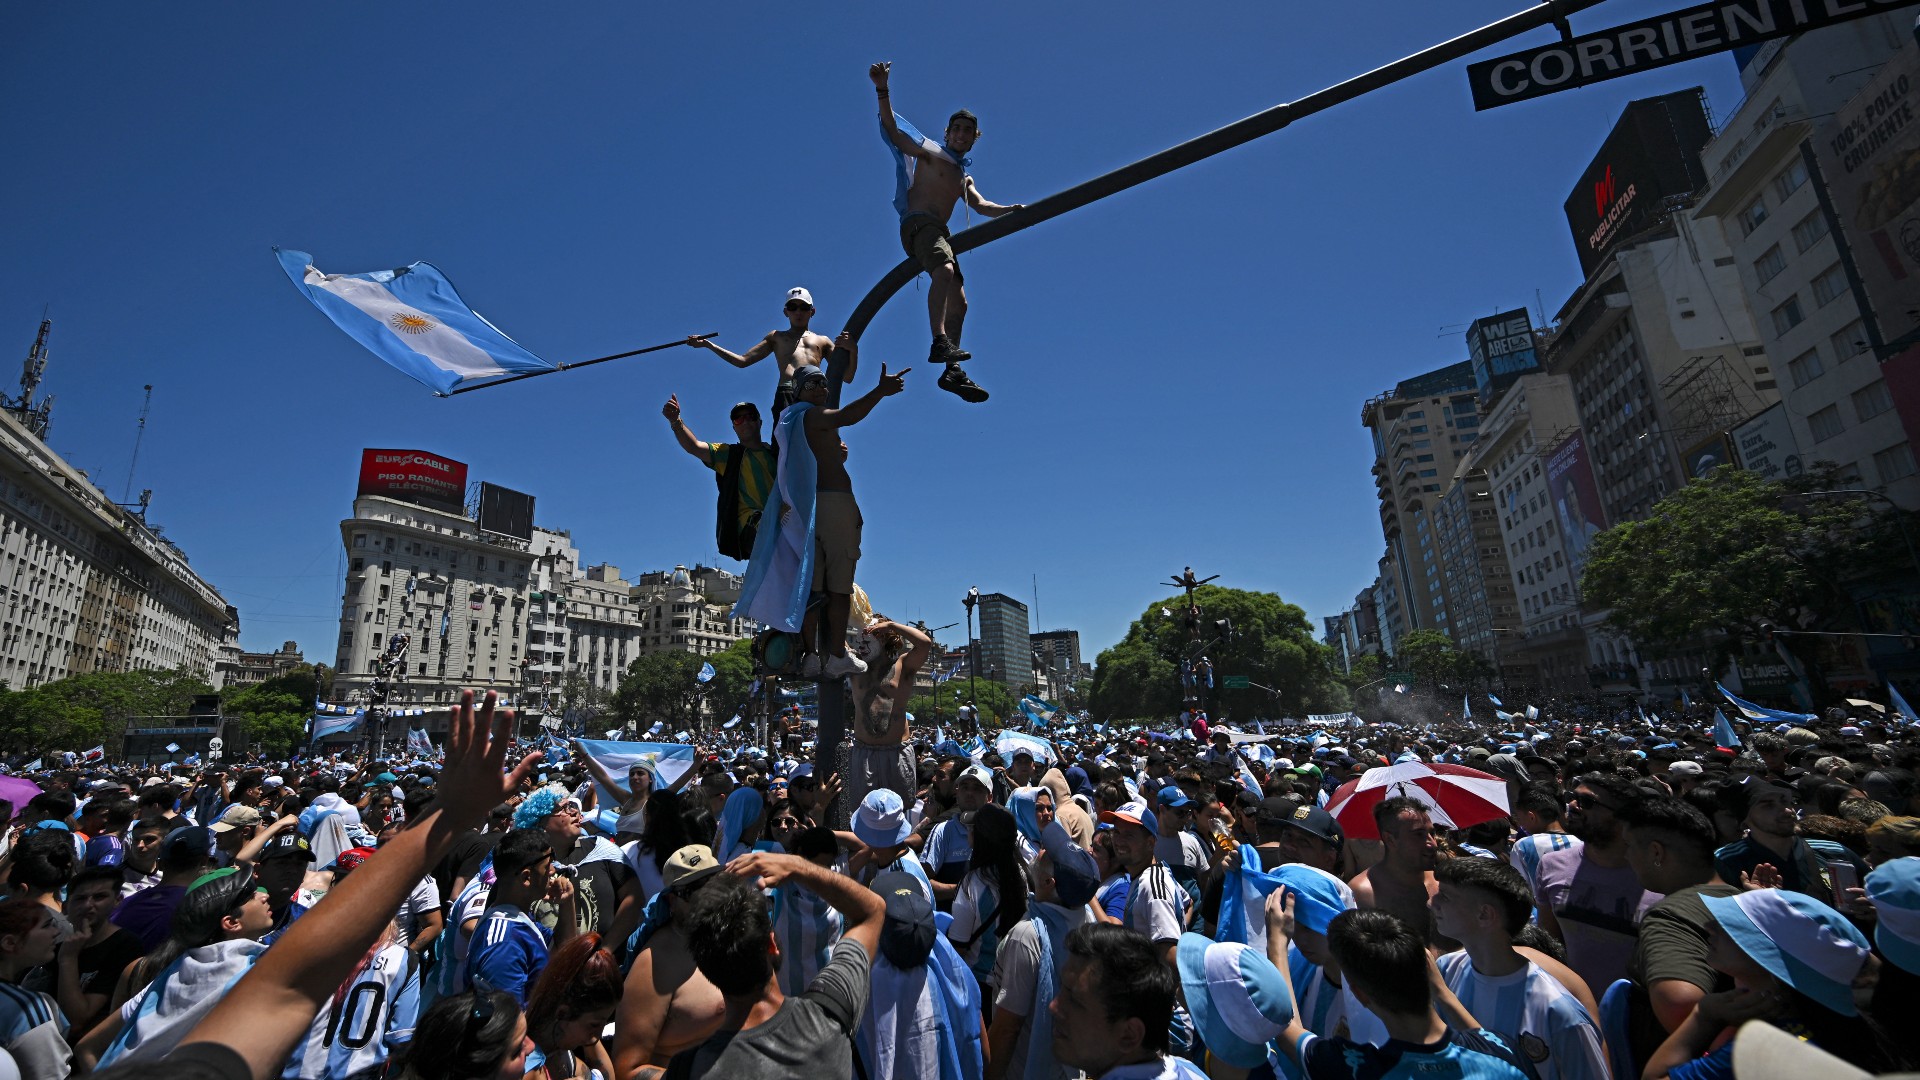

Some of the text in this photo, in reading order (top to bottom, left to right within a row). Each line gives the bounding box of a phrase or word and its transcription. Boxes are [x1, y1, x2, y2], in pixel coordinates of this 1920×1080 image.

[1490, 0, 1900, 97] CORRIEN
[1830, 74, 1909, 157] 100% POLLO
[1843, 100, 1914, 174] CRUJIENTE
[1589, 183, 1637, 249] PUBLICITAR
[1483, 316, 1529, 341] WE
[1487, 339, 1510, 358] ARE
[1741, 433, 1763, 450] Extra
[1745, 440, 1777, 460] tamaño,
[375, 453, 450, 472] EUROCABLE
[1748, 456, 1769, 470] extra
[388, 481, 448, 497] ELÉCTRICO
[408, 473, 459, 491] RADIANTE
[322, 981, 385, 1050] 10
